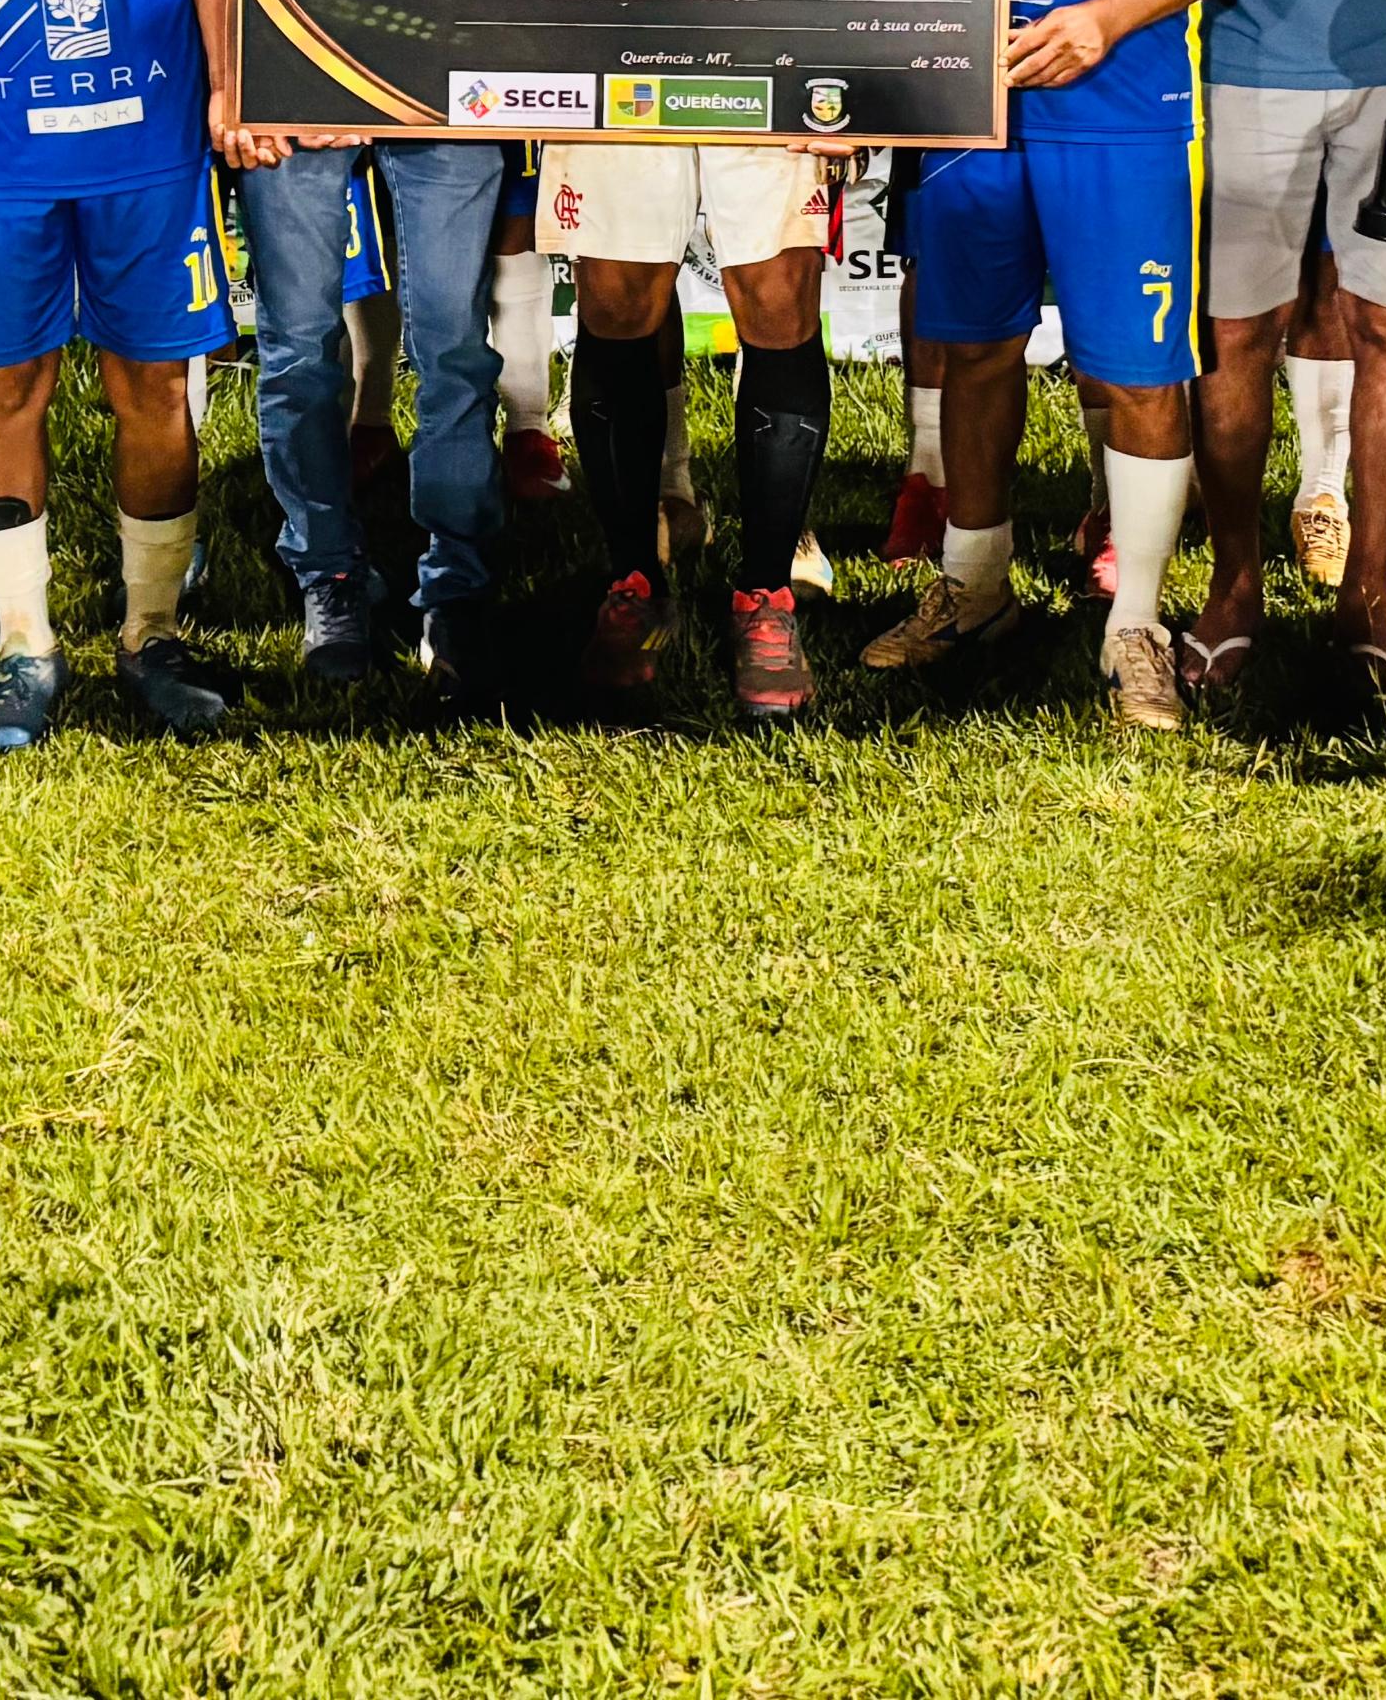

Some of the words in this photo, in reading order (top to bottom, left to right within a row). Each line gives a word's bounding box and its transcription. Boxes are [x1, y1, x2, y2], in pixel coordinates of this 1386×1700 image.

[847, 21, 867, 32] ou
[870, 19, 880, 32] à
[883, 21, 910, 32] sua
[914, 20, 967, 33] ordem.
[620, 51, 694, 66] Querência
[706, 52, 732, 68] MT,
[776, 54, 794, 67] de
[911, 56, 929, 69] de
[932, 56, 973, 70] 2026.
[504, 89, 589, 109] SECEL
[665, 93, 763, 111] QUERÊNCIA
[44, 104, 131, 129] BANK
[183, 243, 218, 313] 10
[1142, 282, 1173, 343] 7
